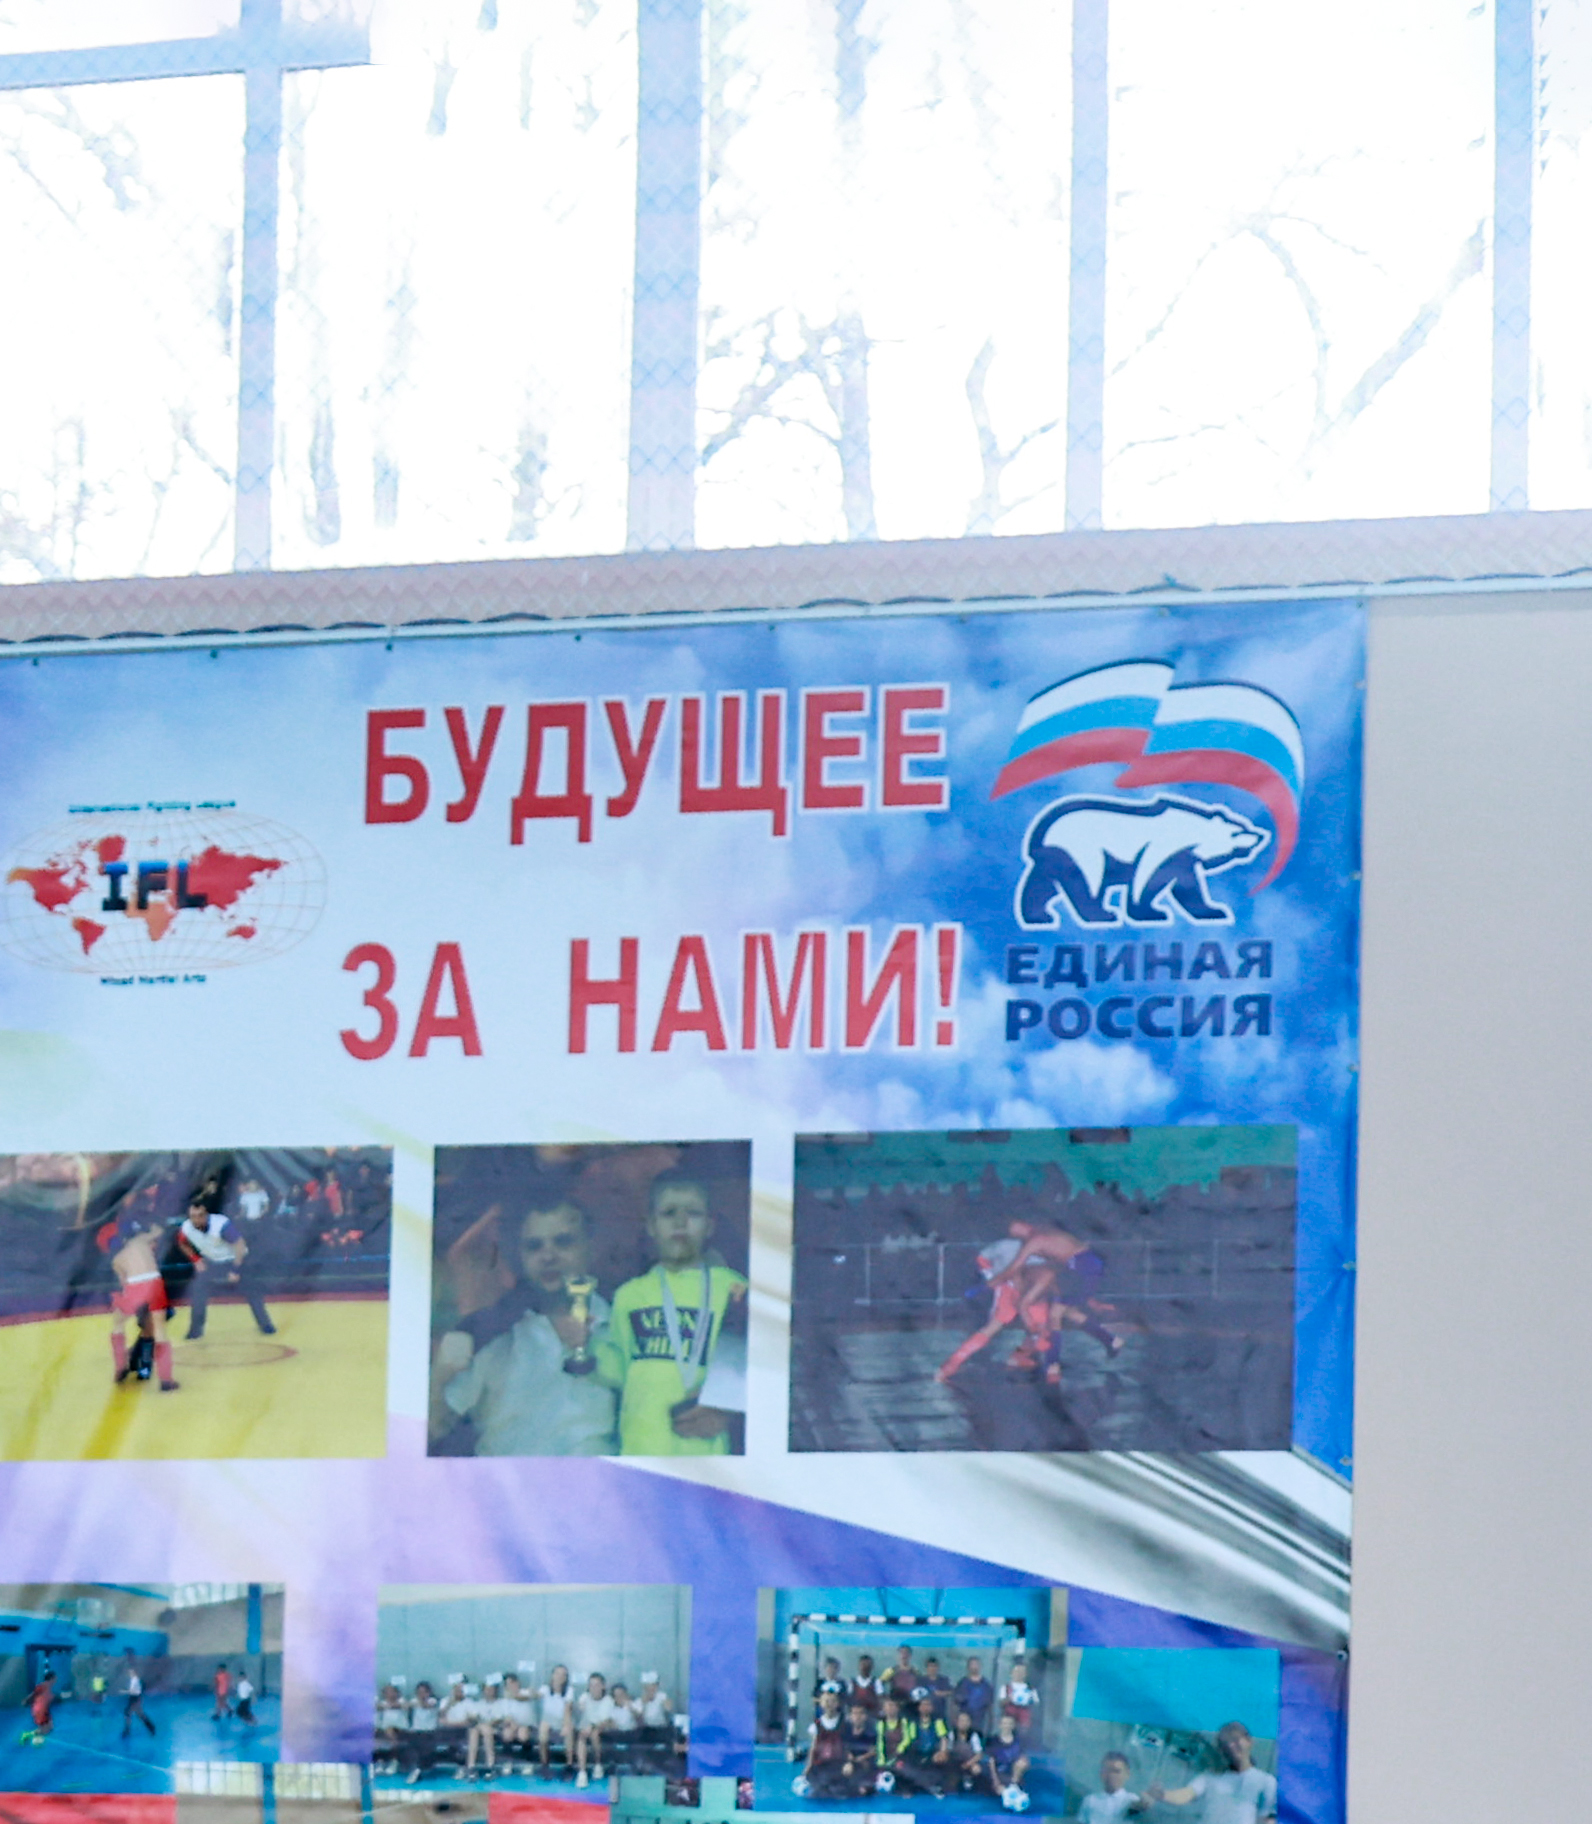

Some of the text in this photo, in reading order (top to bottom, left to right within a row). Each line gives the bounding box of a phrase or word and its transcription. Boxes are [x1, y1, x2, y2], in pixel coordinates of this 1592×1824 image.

[363, 686, 946, 846] БУДУЩЕЕ
[101, 860, 210, 912] IFL
[1007, 939, 1274, 989] ЕДИНАЯ
[338, 927, 958, 1060] ЗА НАМИ!
[1005, 993, 1273, 1041] РОССИЯ
